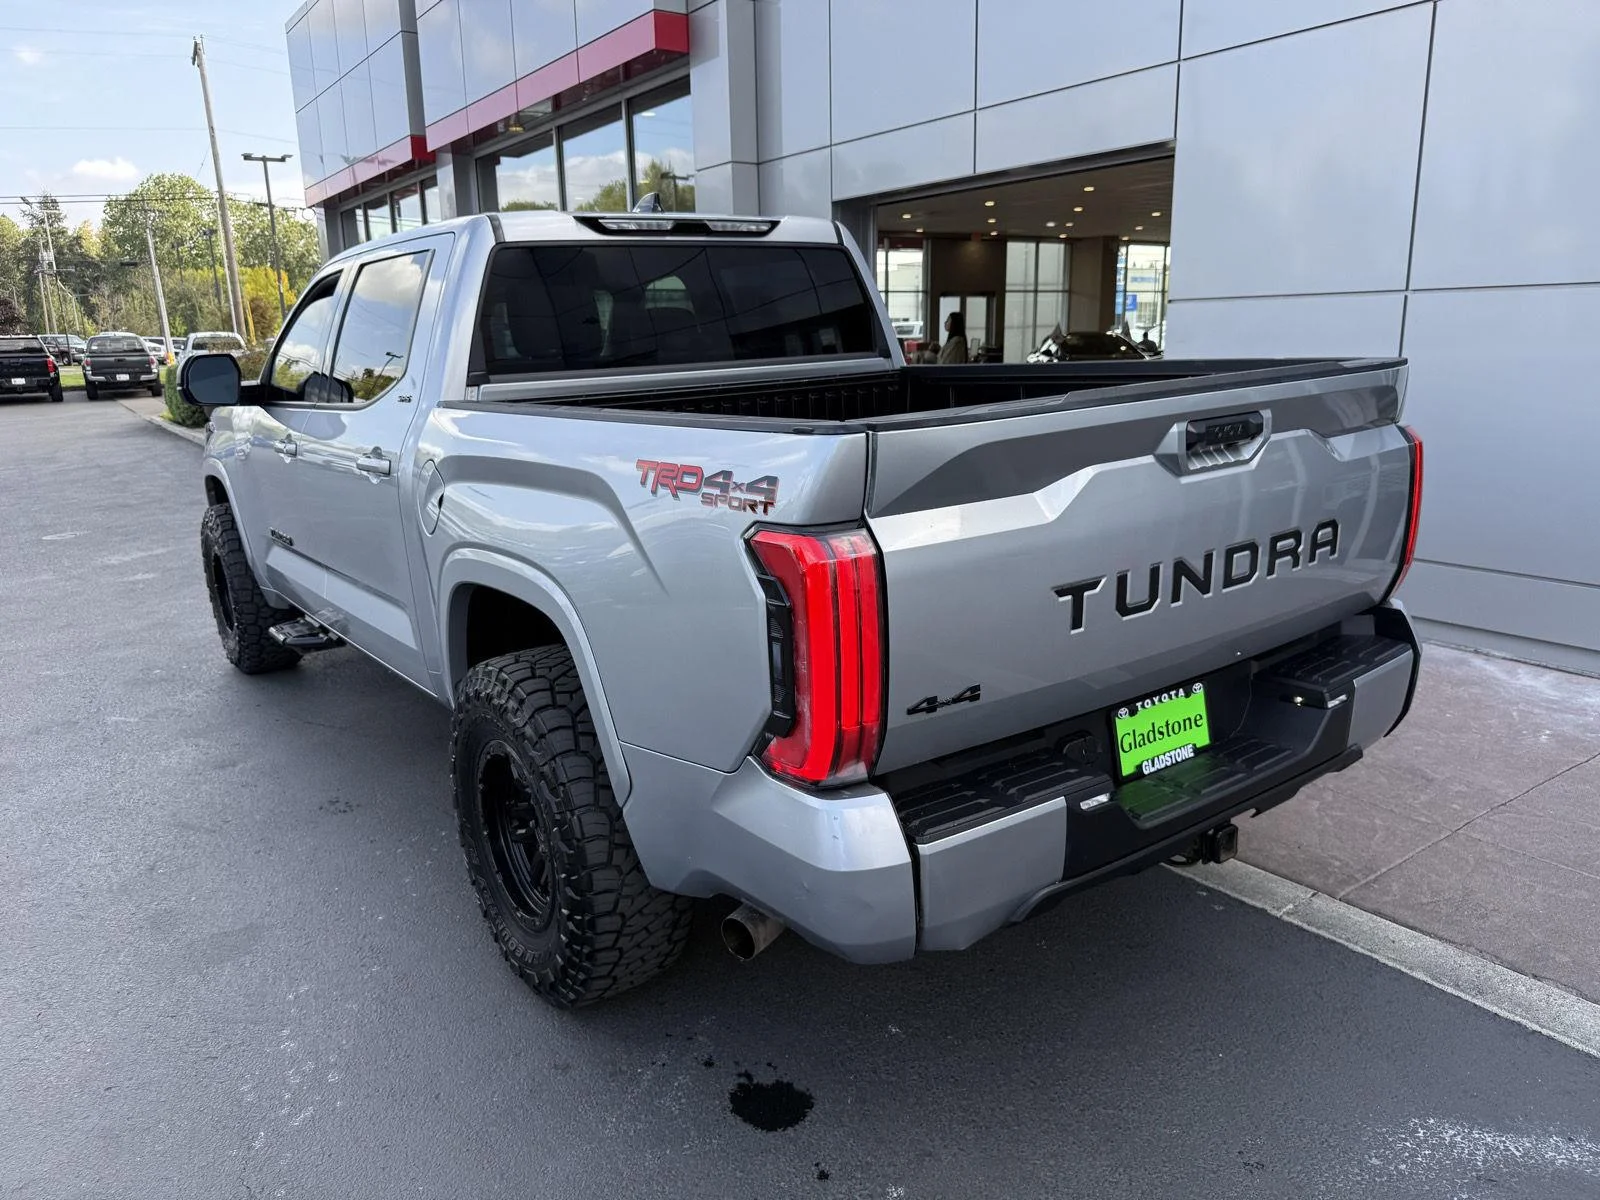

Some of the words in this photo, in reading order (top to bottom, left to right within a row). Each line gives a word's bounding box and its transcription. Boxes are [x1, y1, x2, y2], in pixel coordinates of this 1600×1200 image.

[635, 458, 704, 500] TRD
[701, 492, 776, 516] SPORT
[1051, 518, 1340, 635] TUNDRA
[1135, 688, 1185, 711] TOYOTA
[1120, 713, 1203, 754] Gladstone
[1142, 743, 1195, 775] GLADSTONE
